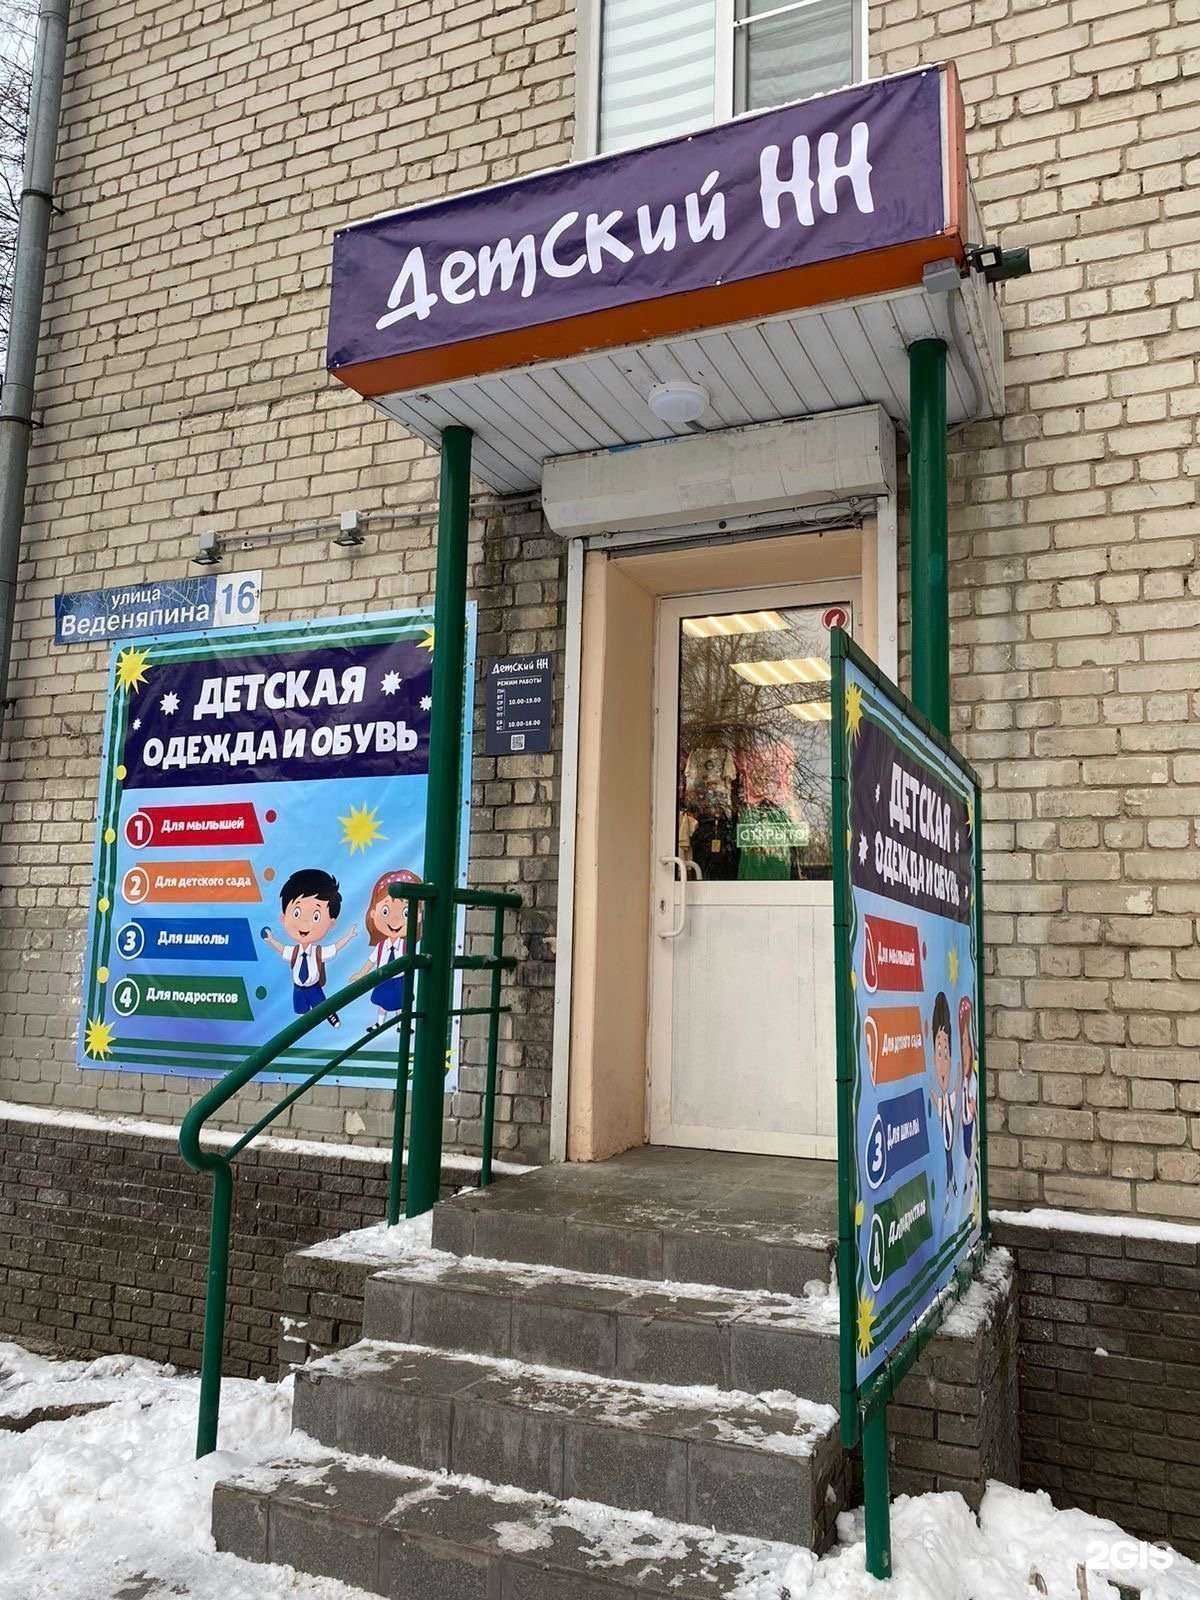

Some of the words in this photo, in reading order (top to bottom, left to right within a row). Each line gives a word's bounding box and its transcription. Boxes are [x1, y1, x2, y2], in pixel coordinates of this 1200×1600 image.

[375, 170, 727, 330] Детский
[759, 121, 876, 229] НН
[111, 586, 162, 608] улица
[220, 580, 256, 616] 16
[61, 601, 210, 637] Веденяпина
[491, 660, 534, 674] Детский
[536, 658, 549, 670] НН
[518, 677, 542, 685] РАБОТЫ
[193, 666, 367, 720] ДЕТСКАЯ
[143, 730, 278, 770] ОДЕЖДА
[282, 729, 306, 758] И
[311, 721, 418, 756] ОБУВЬ
[889, 761, 951, 853] ДЕТСКАЯ
[134, 820, 144, 841] 1
[161, 819, 184, 833] Для
[874, 831, 925, 896] ОДЕЖДА
[925, 857, 934, 897] И
[933, 862, 960, 907] ОБУВЬ
[130, 875, 141, 896] 2
[155, 876, 177, 888] Для
[178, 876, 224, 889] детского
[226, 876, 251, 889] сада
[123, 930, 136, 951] 3
[157, 931, 183, 946] Для
[184, 933, 229, 946] школы
[120, 986, 132, 1008] 4
[146, 987, 171, 1001] Для
[172, 989, 239, 1005] подростков
[871, 1131, 883, 1173] 3
[872, 1231, 881, 1273] 4
